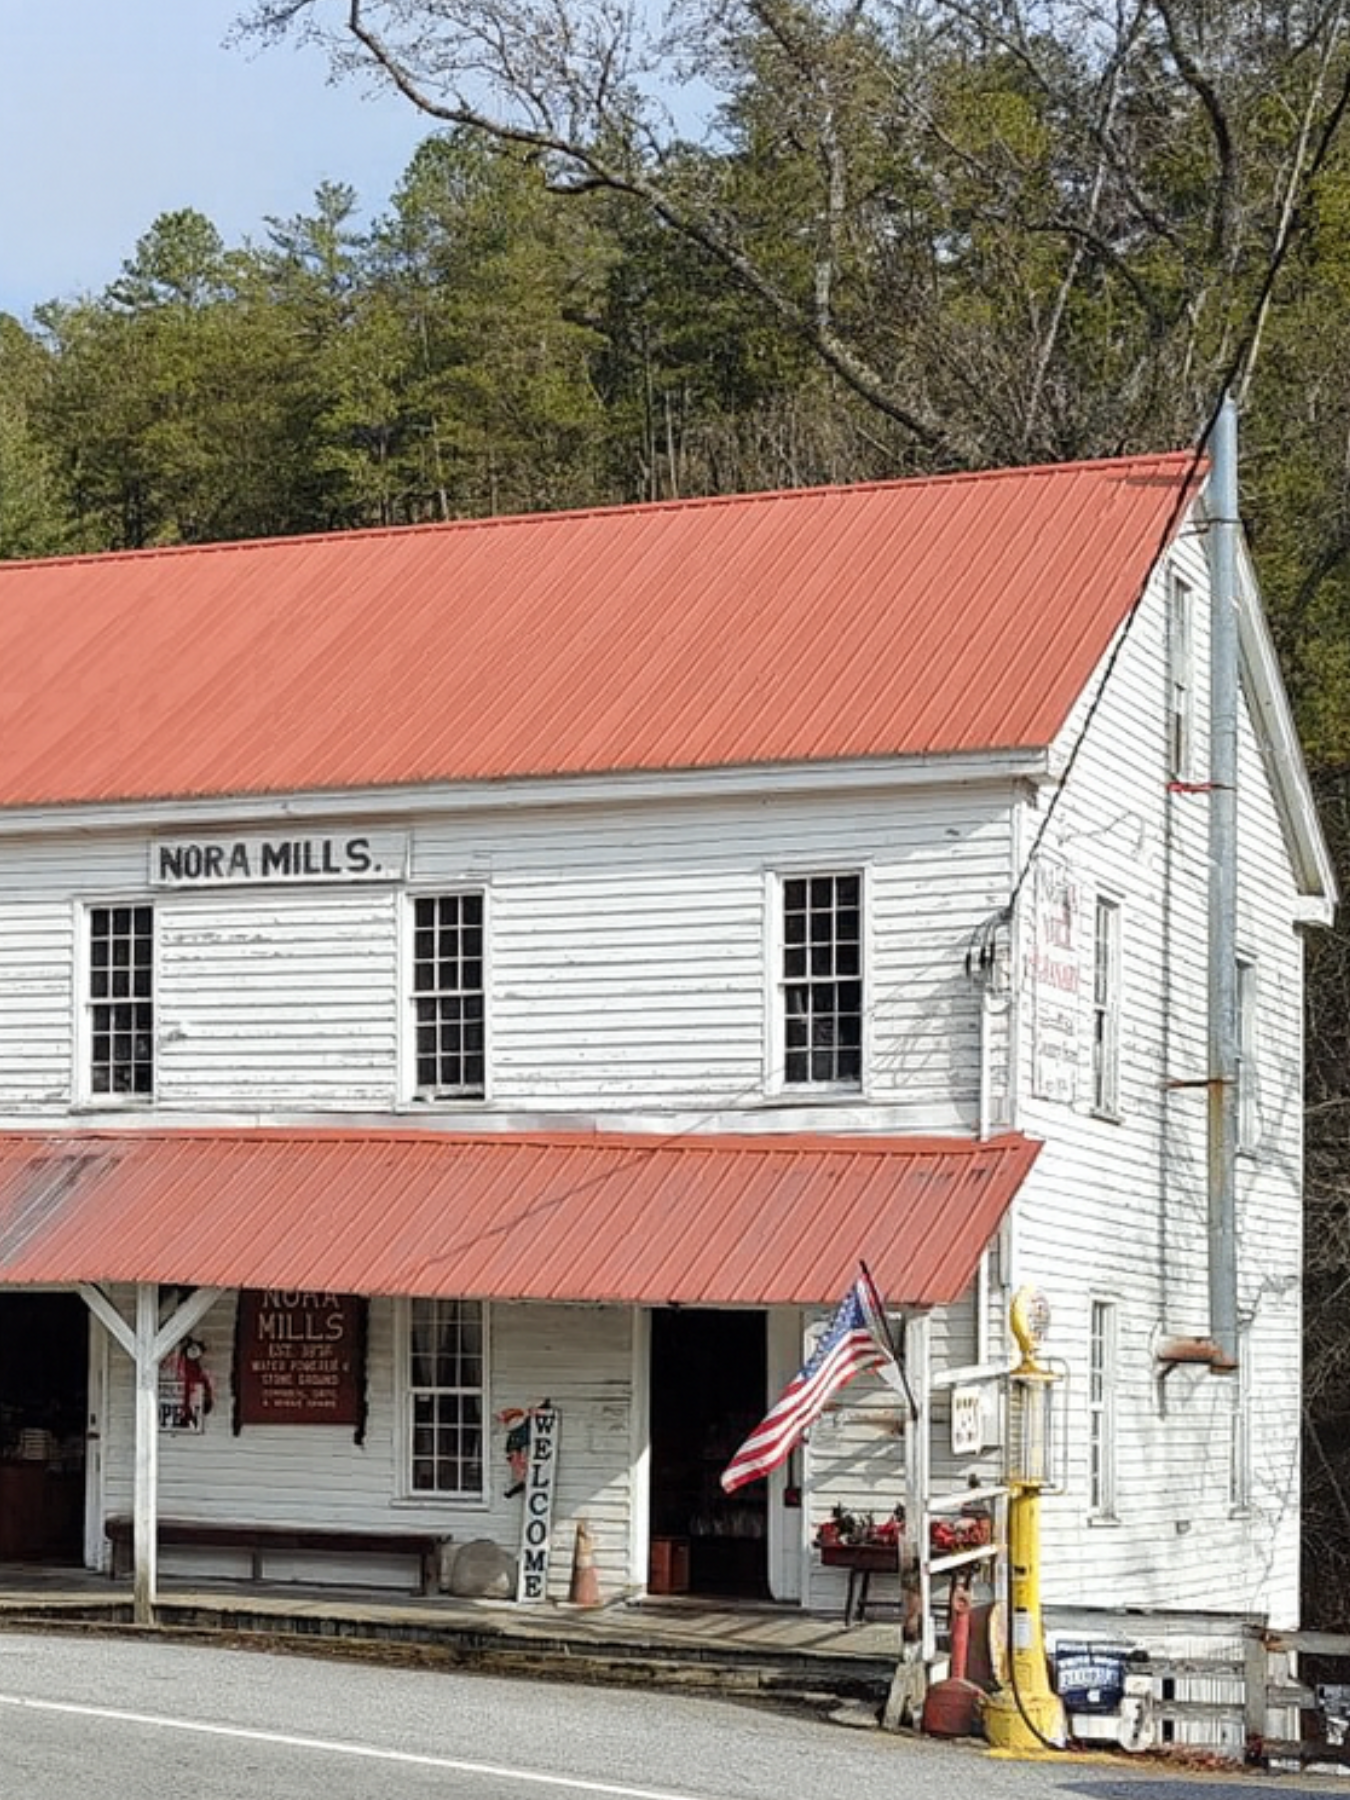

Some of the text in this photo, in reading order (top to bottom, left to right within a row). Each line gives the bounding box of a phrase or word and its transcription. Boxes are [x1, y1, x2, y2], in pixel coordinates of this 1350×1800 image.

[159, 838, 382, 880] NORA MILLS.
[258, 1313, 345, 1340] MILLS
[291, 1358, 338, 1371] POWERED
[298, 1374, 340, 1385] GROUND
[525, 1414, 555, 1598] WELCOME
